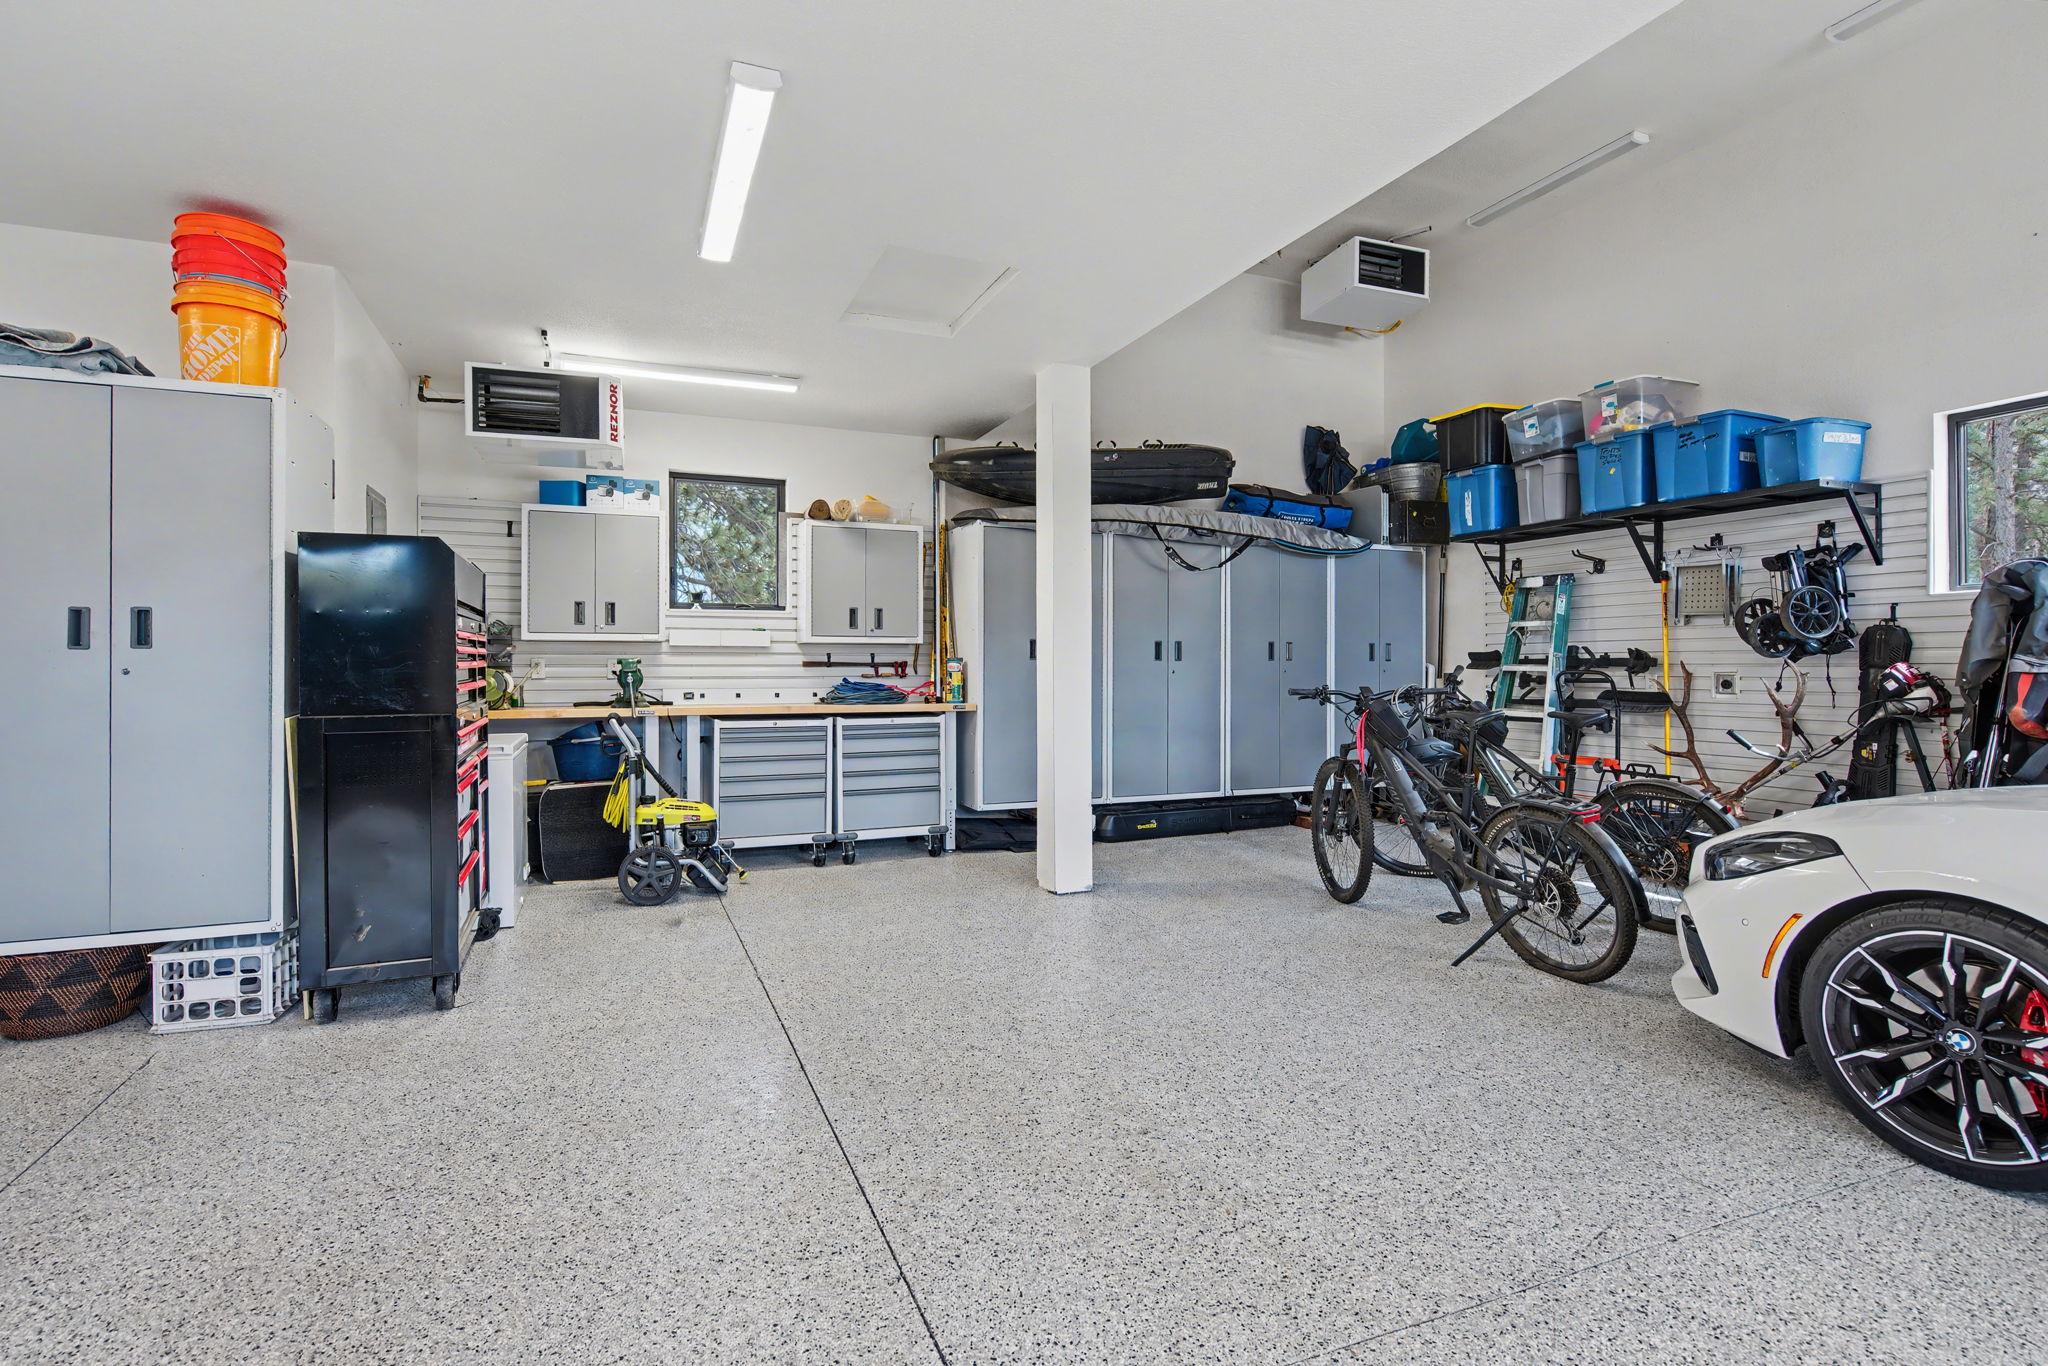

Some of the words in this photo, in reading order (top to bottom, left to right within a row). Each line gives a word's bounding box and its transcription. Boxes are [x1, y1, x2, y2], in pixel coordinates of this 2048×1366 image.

[184, 331, 204, 354] THE
[197, 349, 240, 382] DEPOT
[609, 383, 619, 443] REZNOR
